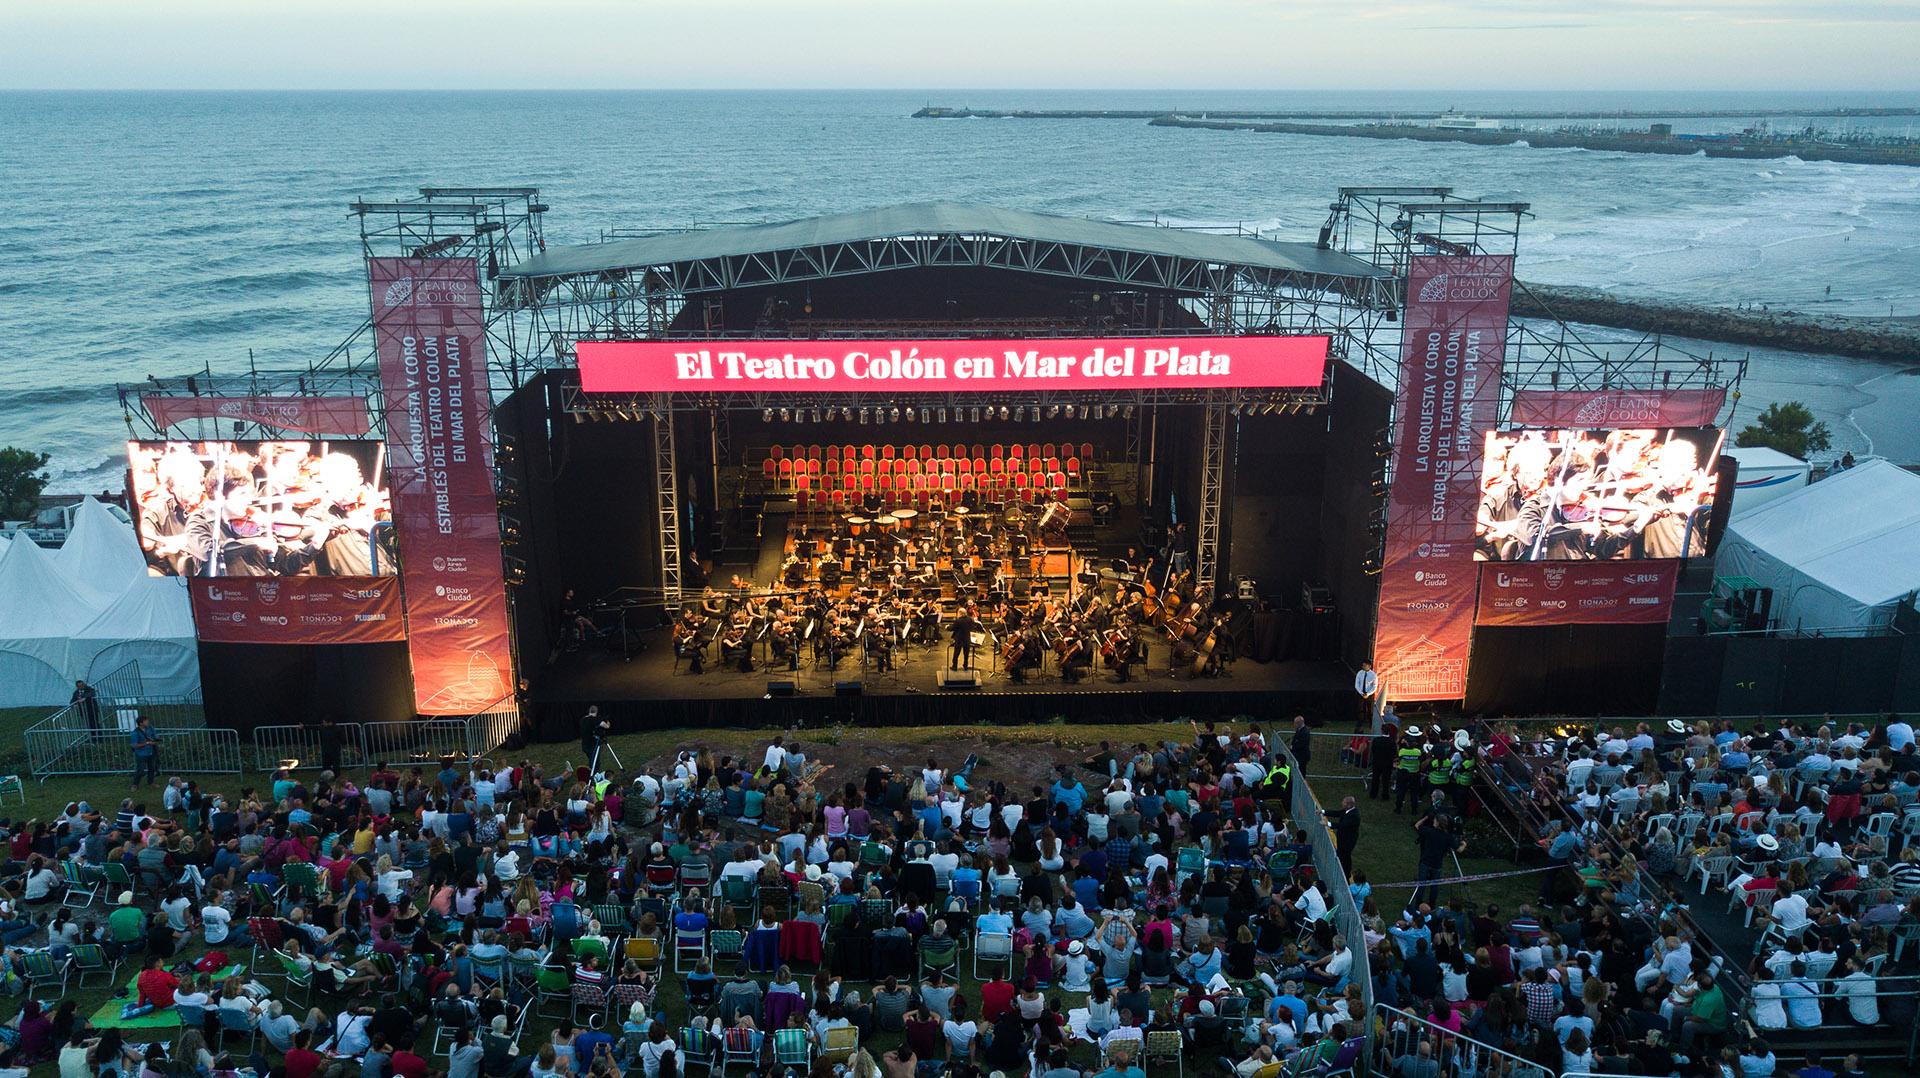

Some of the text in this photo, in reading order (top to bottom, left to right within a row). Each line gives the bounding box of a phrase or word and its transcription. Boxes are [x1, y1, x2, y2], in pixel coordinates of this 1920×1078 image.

[415, 281, 467, 290] TEATRO
[1452, 277, 1500, 287] TEATRO
[416, 290, 467, 302] COLÓN
[1450, 286, 1498, 299] COLÓN
[674, 347, 1231, 379] El Teatro Colón en Mar del Plata
[1458, 330, 1480, 452] EN MAR DEL PLATA
[445, 336, 466, 462] EN MAR DEL PLATA
[1415, 332, 1441, 472] LA ORQUESTA Y CORO
[1613, 399, 1660, 408] TEATRO
[246, 404, 298, 416] TEATRO
[402, 336, 427, 482] LA ORQUESTA Y CORO
[1610, 408, 1659, 420] COLÓN
[1431, 332, 1461, 521] ESTABLES DEL TEATRO COLÓN
[422, 337, 452, 534] ESTABLES DEL TEATRO COLÓN
[1637, 574, 1658, 582] RUS
[358, 589, 381, 598] RUS
[355, 614, 386, 622] PLUSMAR
